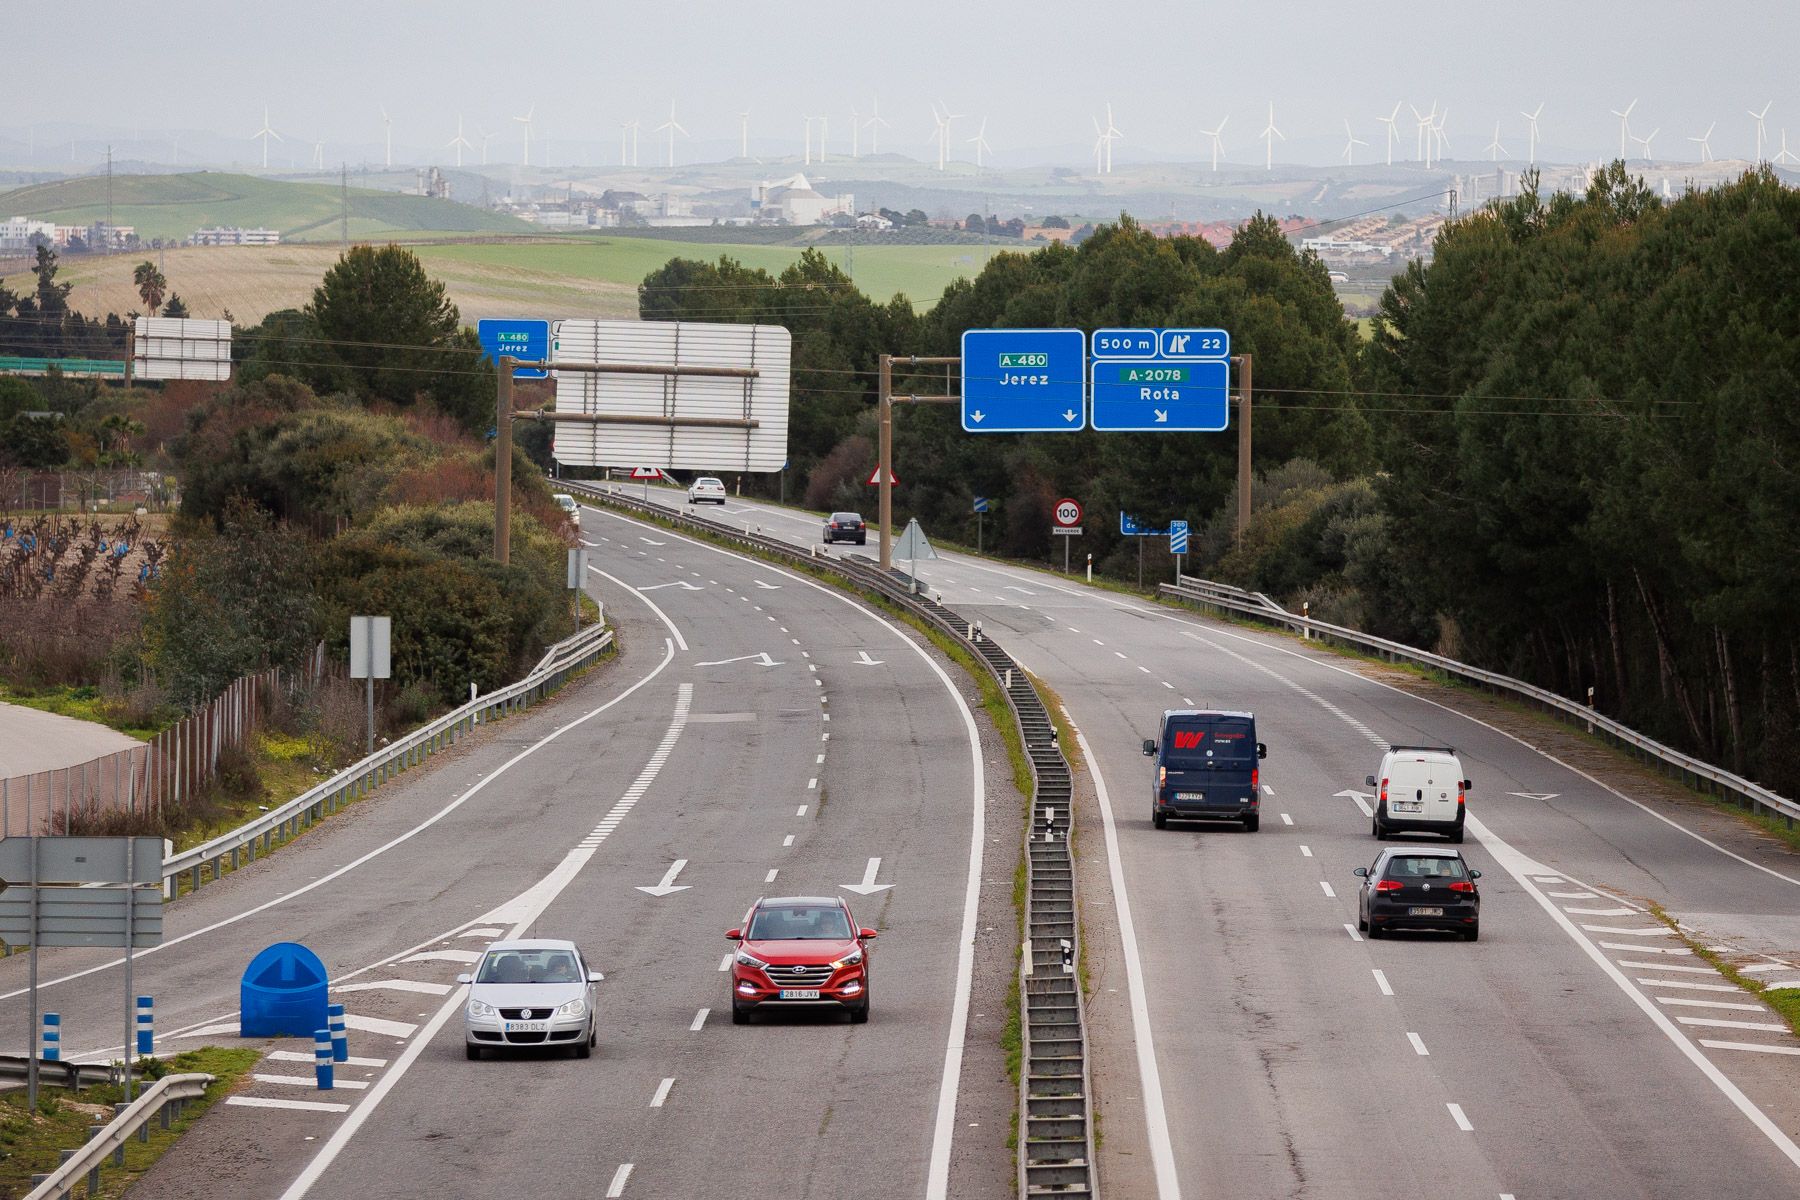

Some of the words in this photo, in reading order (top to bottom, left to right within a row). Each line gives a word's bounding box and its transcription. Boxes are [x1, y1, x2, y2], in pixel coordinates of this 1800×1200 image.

[498, 344, 528, 352] Jerez
[1101, 338, 1132, 349] 500
[1138, 340, 1150, 349] m
[1202, 338, 1221, 349] 22
[1001, 355, 1046, 366] A-480
[1000, 372, 1049, 385] Jerez
[1128, 369, 1181, 381] A-2078
[1140, 387, 1180, 400] Rota
[1058, 508, 1078, 518] 100
[785, 990, 803, 998] 2816
[804, 990, 818, 998] JVX
[510, 1023, 529, 1031] 8383
